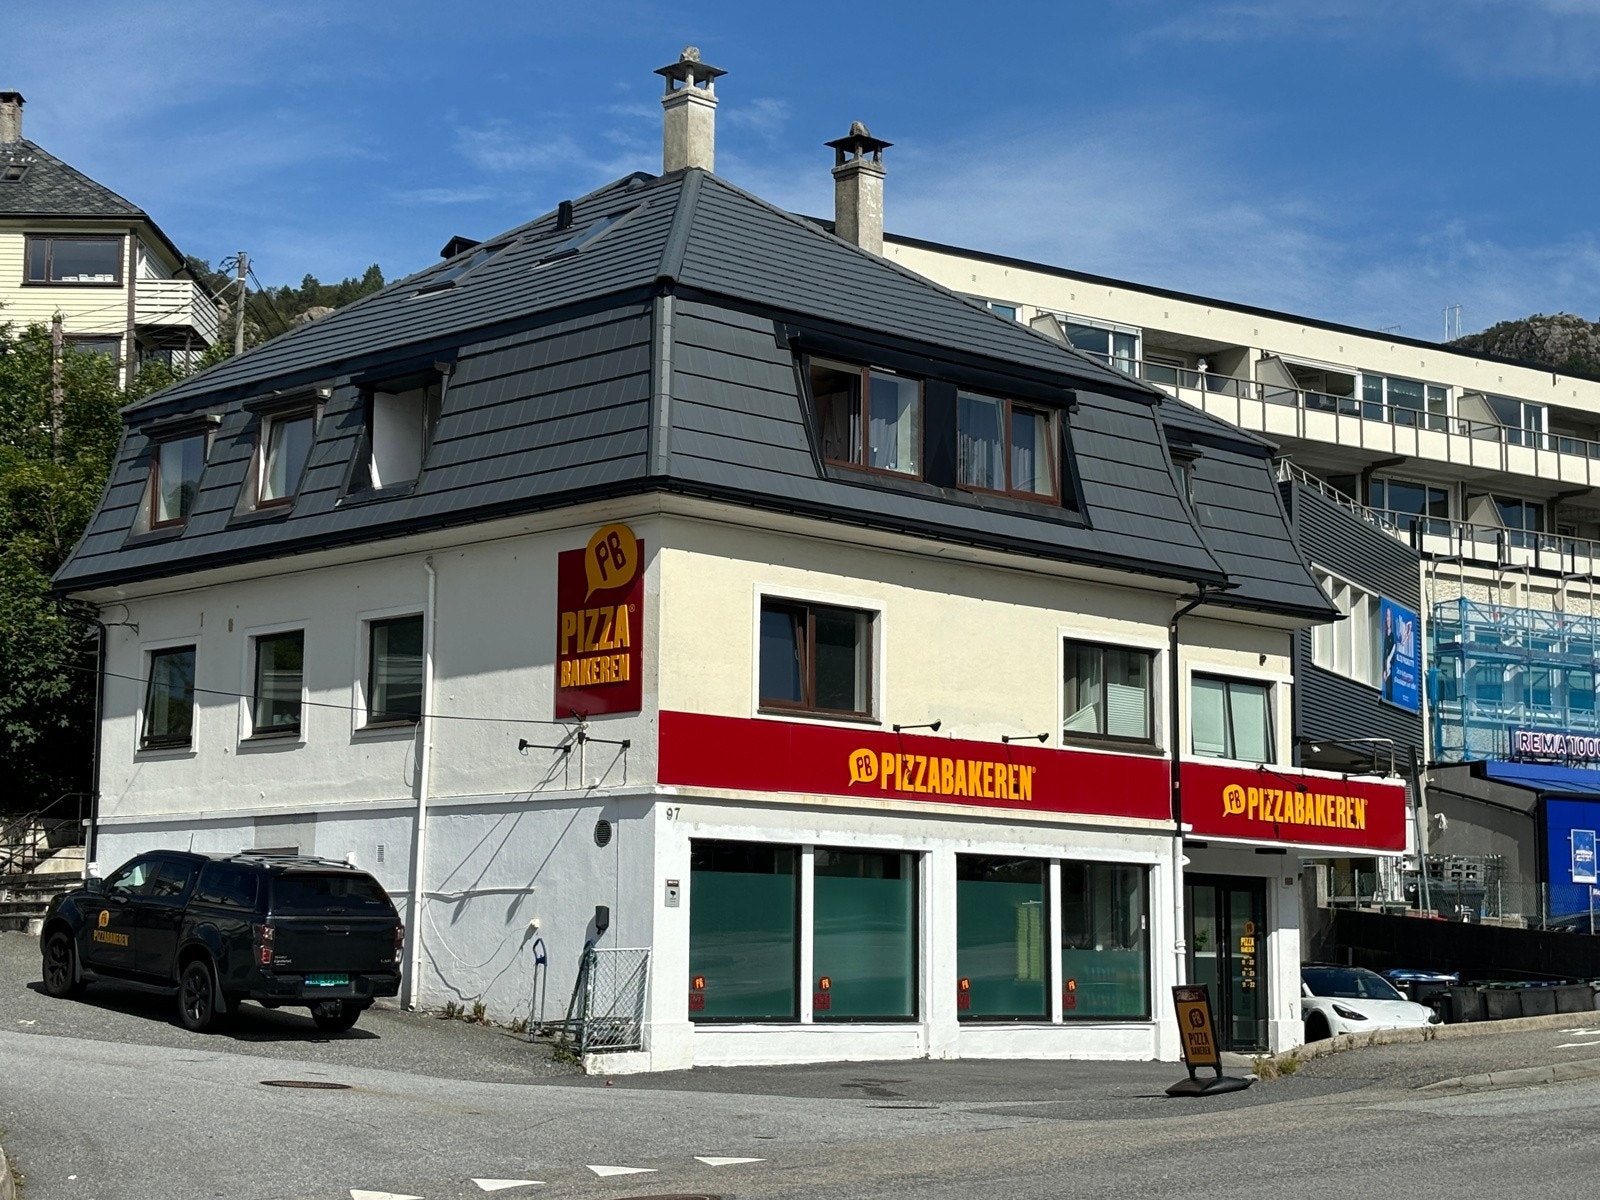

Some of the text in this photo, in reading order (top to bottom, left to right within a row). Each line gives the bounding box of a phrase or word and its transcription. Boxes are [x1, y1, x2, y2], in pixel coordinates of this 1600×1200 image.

[594, 530, 627, 582] PB
[560, 653, 630, 688] BAKEREN
[1519, 731, 1567, 755] REMA
[855, 754, 873, 779] PB
[1228, 789, 1242, 811] PB
[666, 807, 681, 821] 97
[1187, 1032, 1210, 1046] PIZZA
